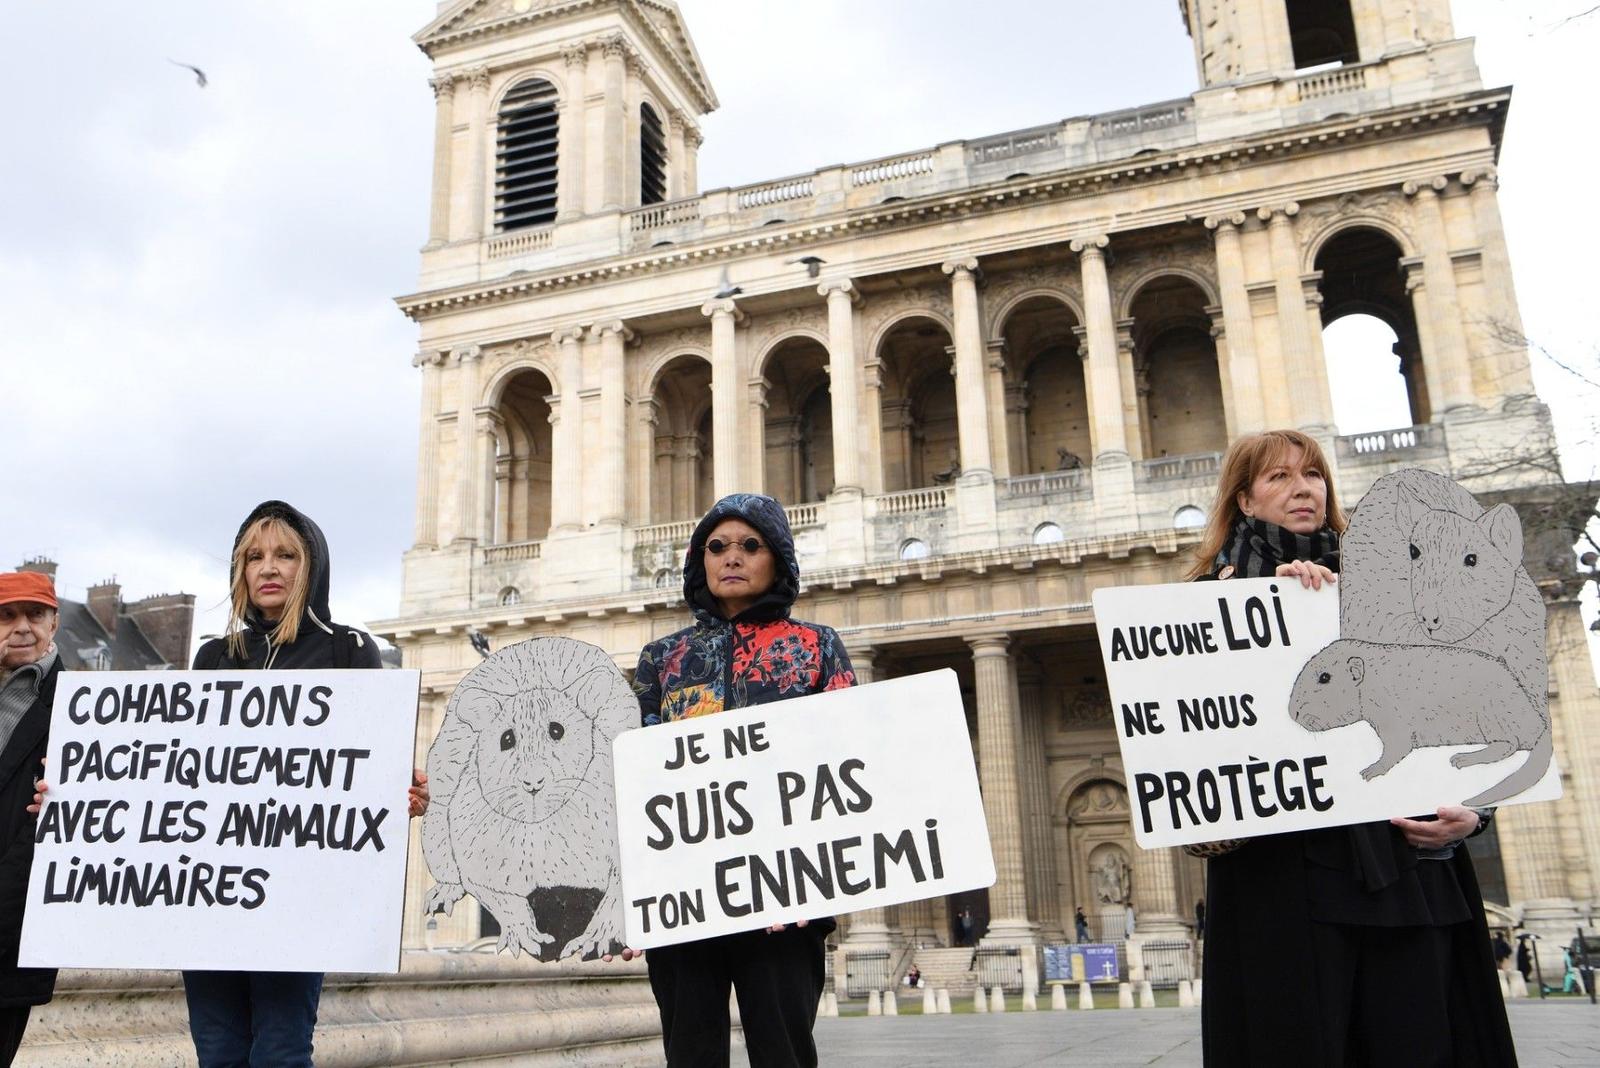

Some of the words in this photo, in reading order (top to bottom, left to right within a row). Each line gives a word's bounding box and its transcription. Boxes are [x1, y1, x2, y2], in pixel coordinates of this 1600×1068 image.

[1111, 621, 1219, 662] AUCUNE
[1121, 701, 1166, 738] NE
[1176, 693, 1258, 733] NOUS
[664, 733, 710, 771] JE
[723, 721, 770, 759] NE
[777, 758, 873, 827] PAS
[1134, 755, 1335, 834] PROTÈGE
[35, 799, 130, 845] AVEC
[138, 800, 208, 844] LES
[632, 888, 706, 934] TON
